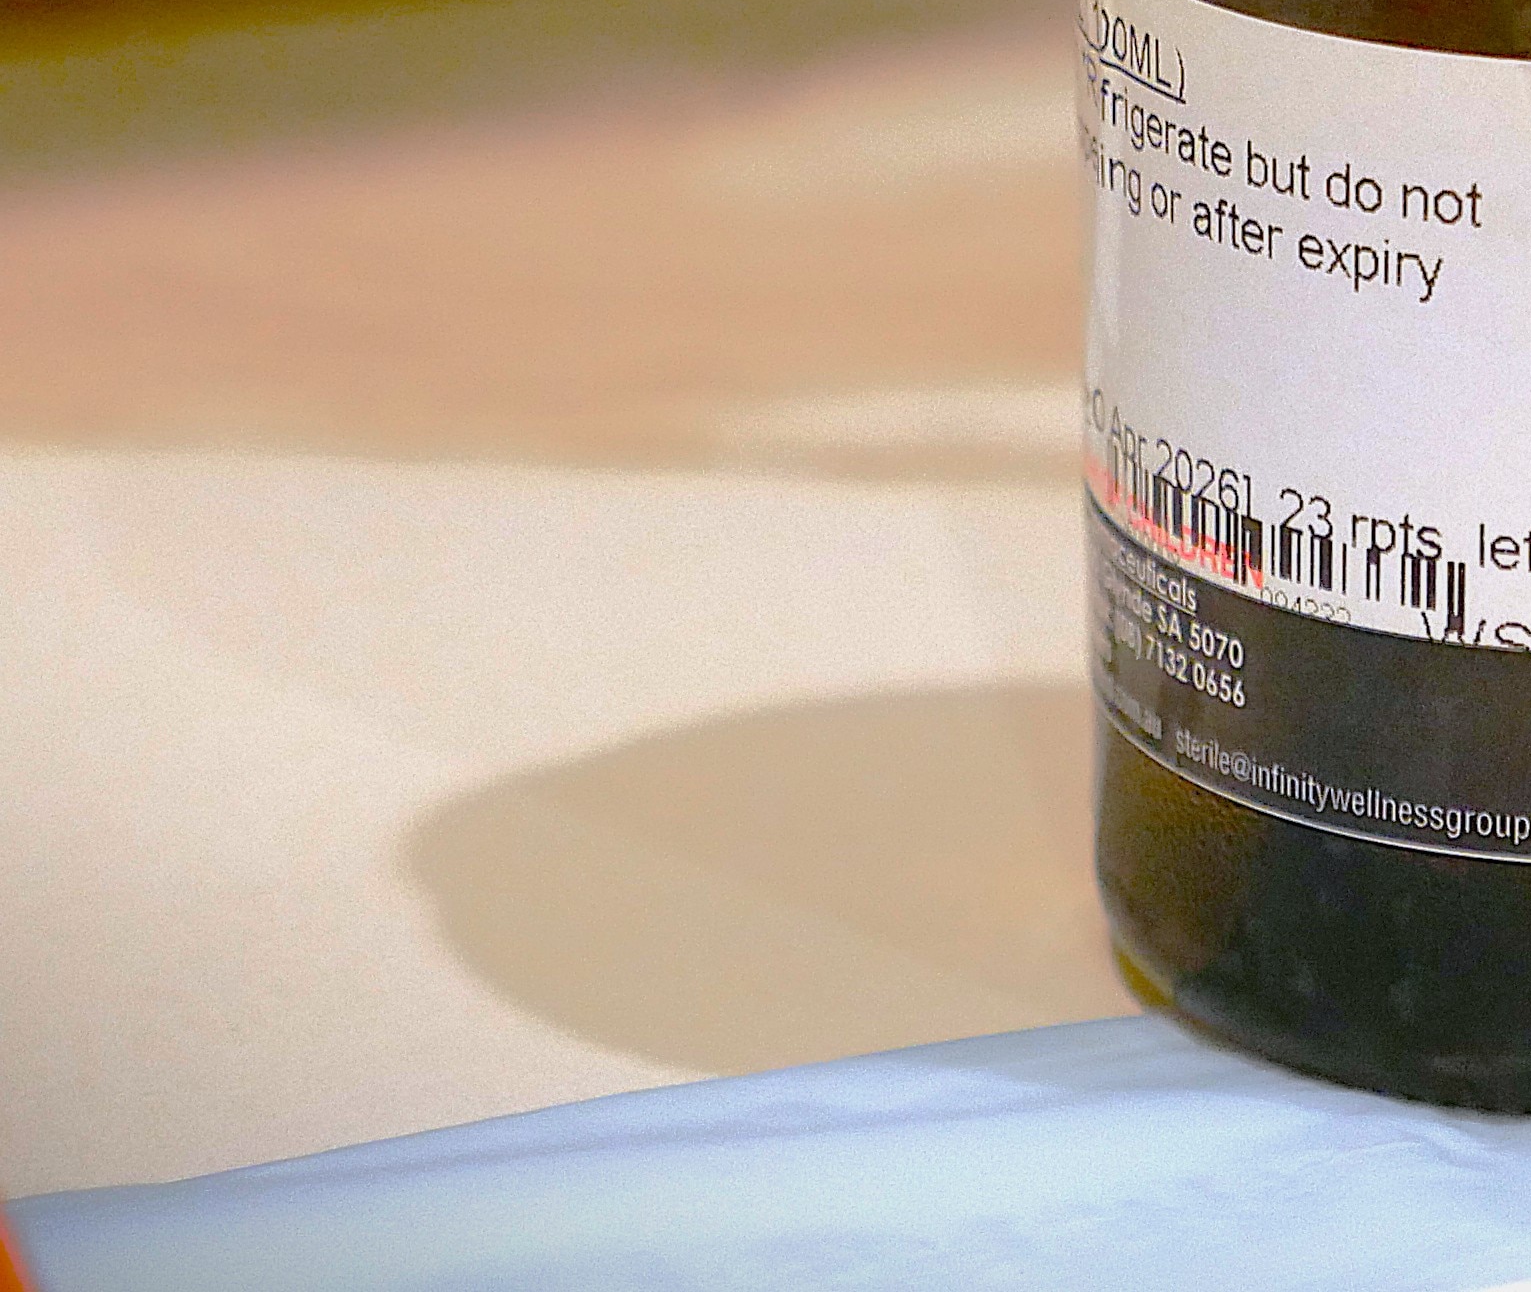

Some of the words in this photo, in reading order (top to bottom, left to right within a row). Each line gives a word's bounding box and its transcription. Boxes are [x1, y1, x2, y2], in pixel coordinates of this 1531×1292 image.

[1246, 139, 1311, 201] but
[1326, 163, 1383, 213] do
[1402, 182, 1483, 228] not
[1151, 182, 1182, 224] or
[1193, 198, 1283, 259] after
[1299, 233, 1444, 304] expiry
[1280, 487, 1334, 540] 23
[1351, 513, 1444, 564] rpts
[1145, 632, 1188, 685] 7132
[1192, 660, 1246, 709] 0656
[1157, 604, 1184, 644] SA
[1188, 619, 1245, 670] 5070
